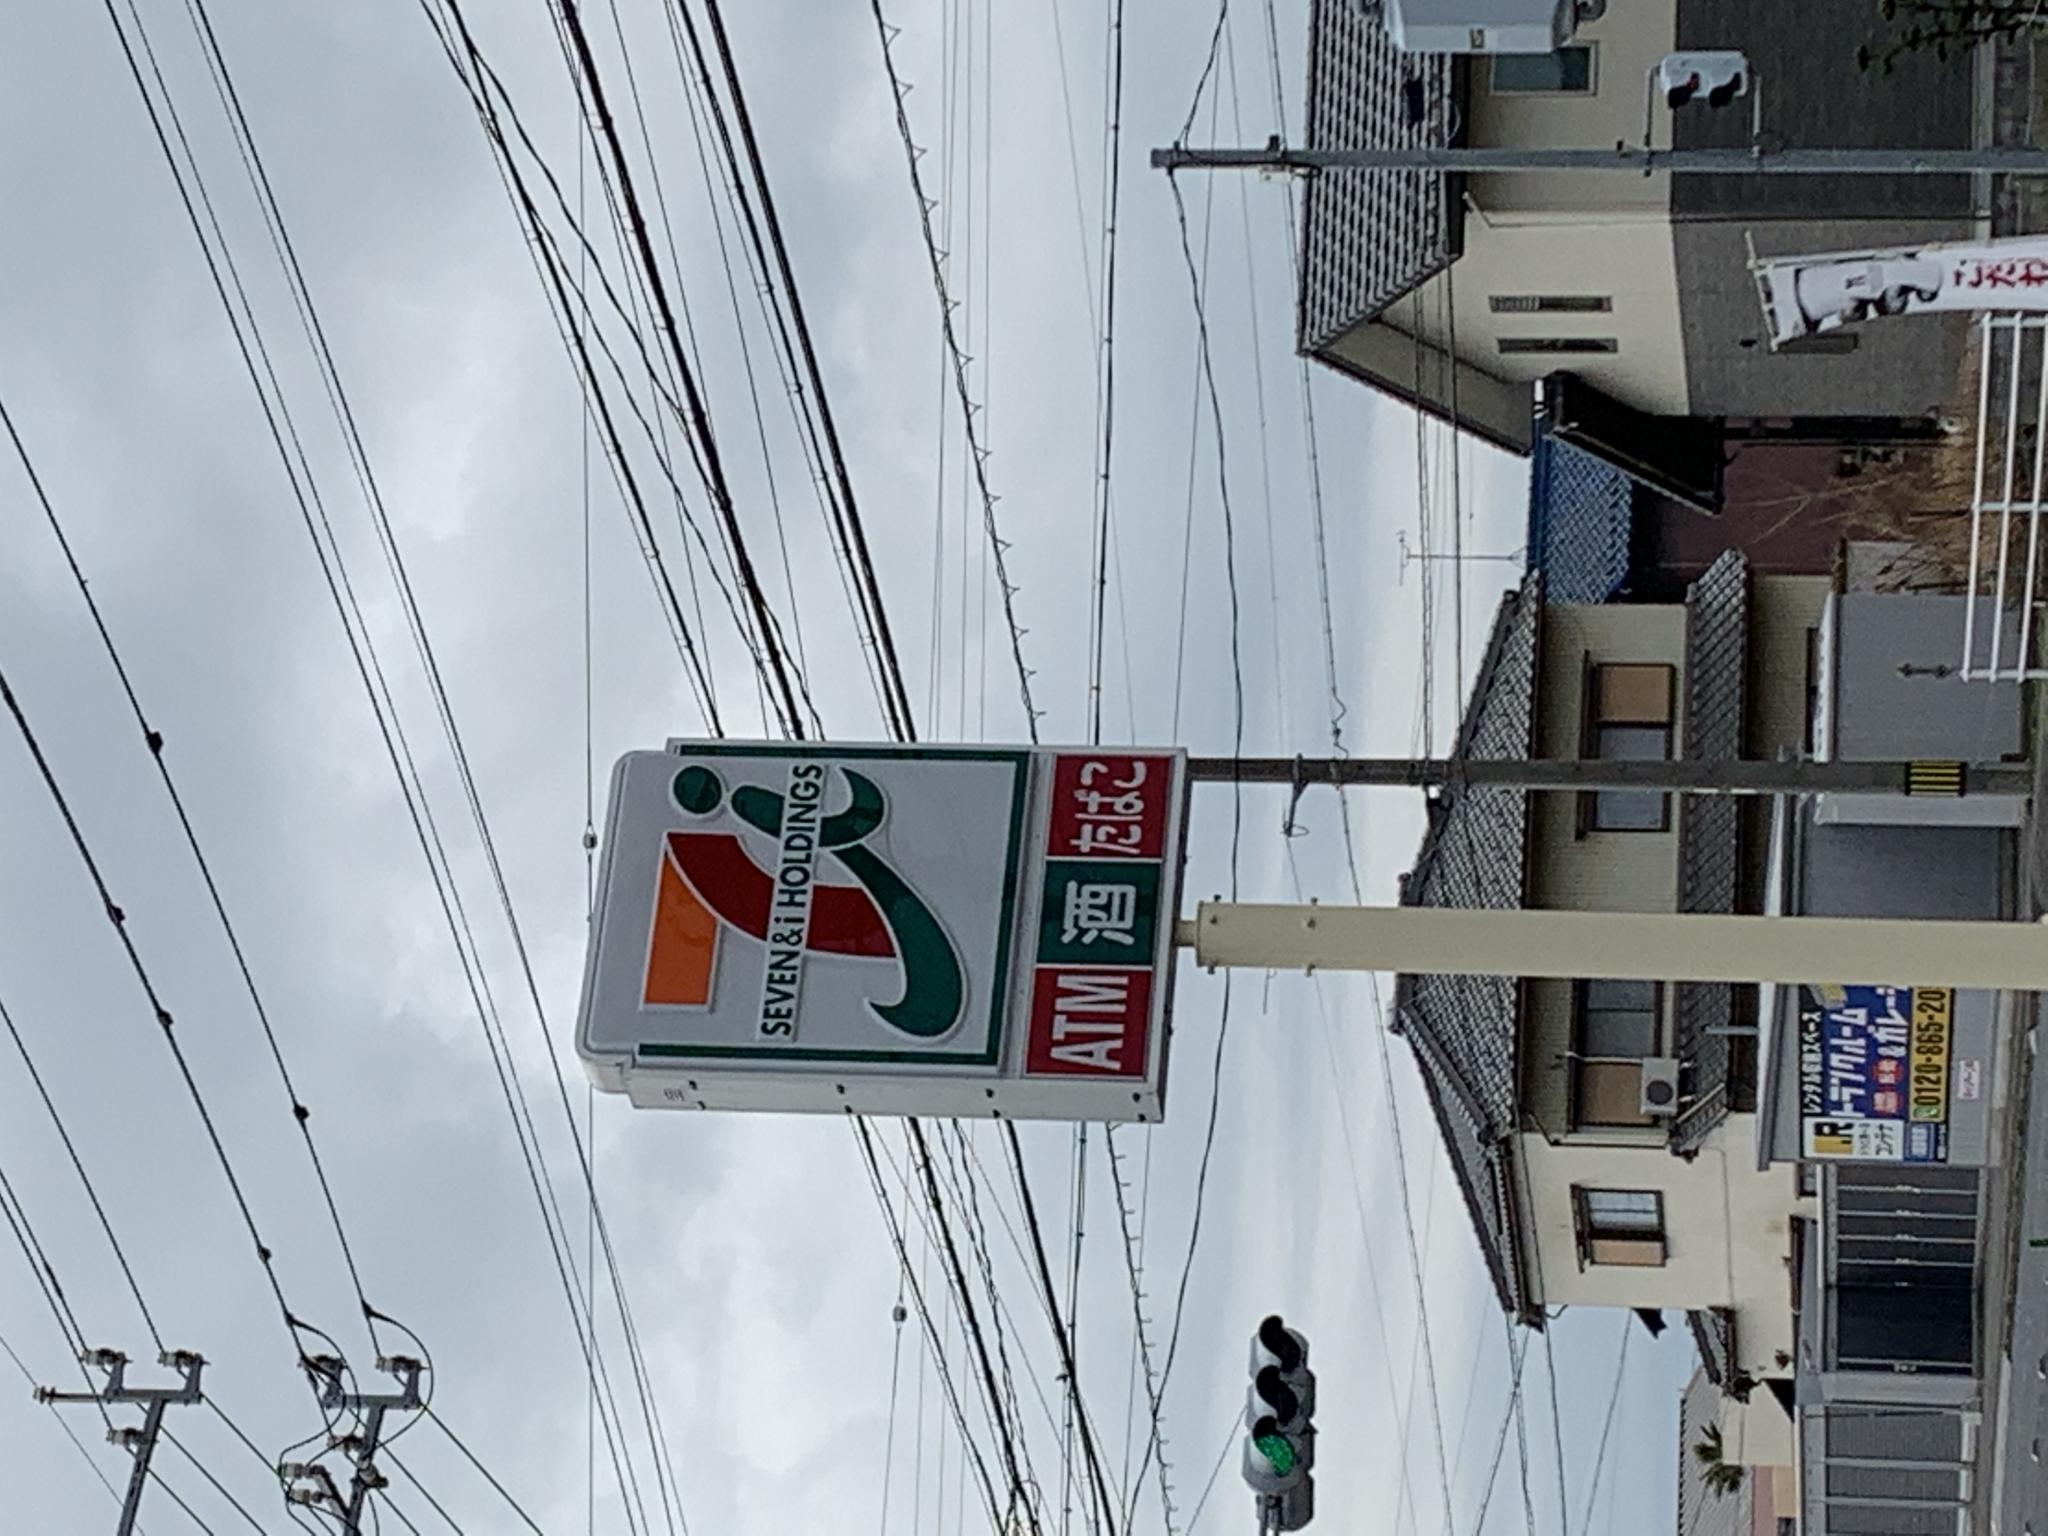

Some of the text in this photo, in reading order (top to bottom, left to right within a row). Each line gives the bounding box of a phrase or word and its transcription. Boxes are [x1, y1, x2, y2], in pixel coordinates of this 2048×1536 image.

[777, 764, 823, 909] HOLDINGS
[1070, 761, 1147, 855] たばこ
[1061, 880, 1136, 946] 酒
[1050, 974, 1130, 1071] ATM
[1828, 1008, 1867, 1118] トランクルーム
